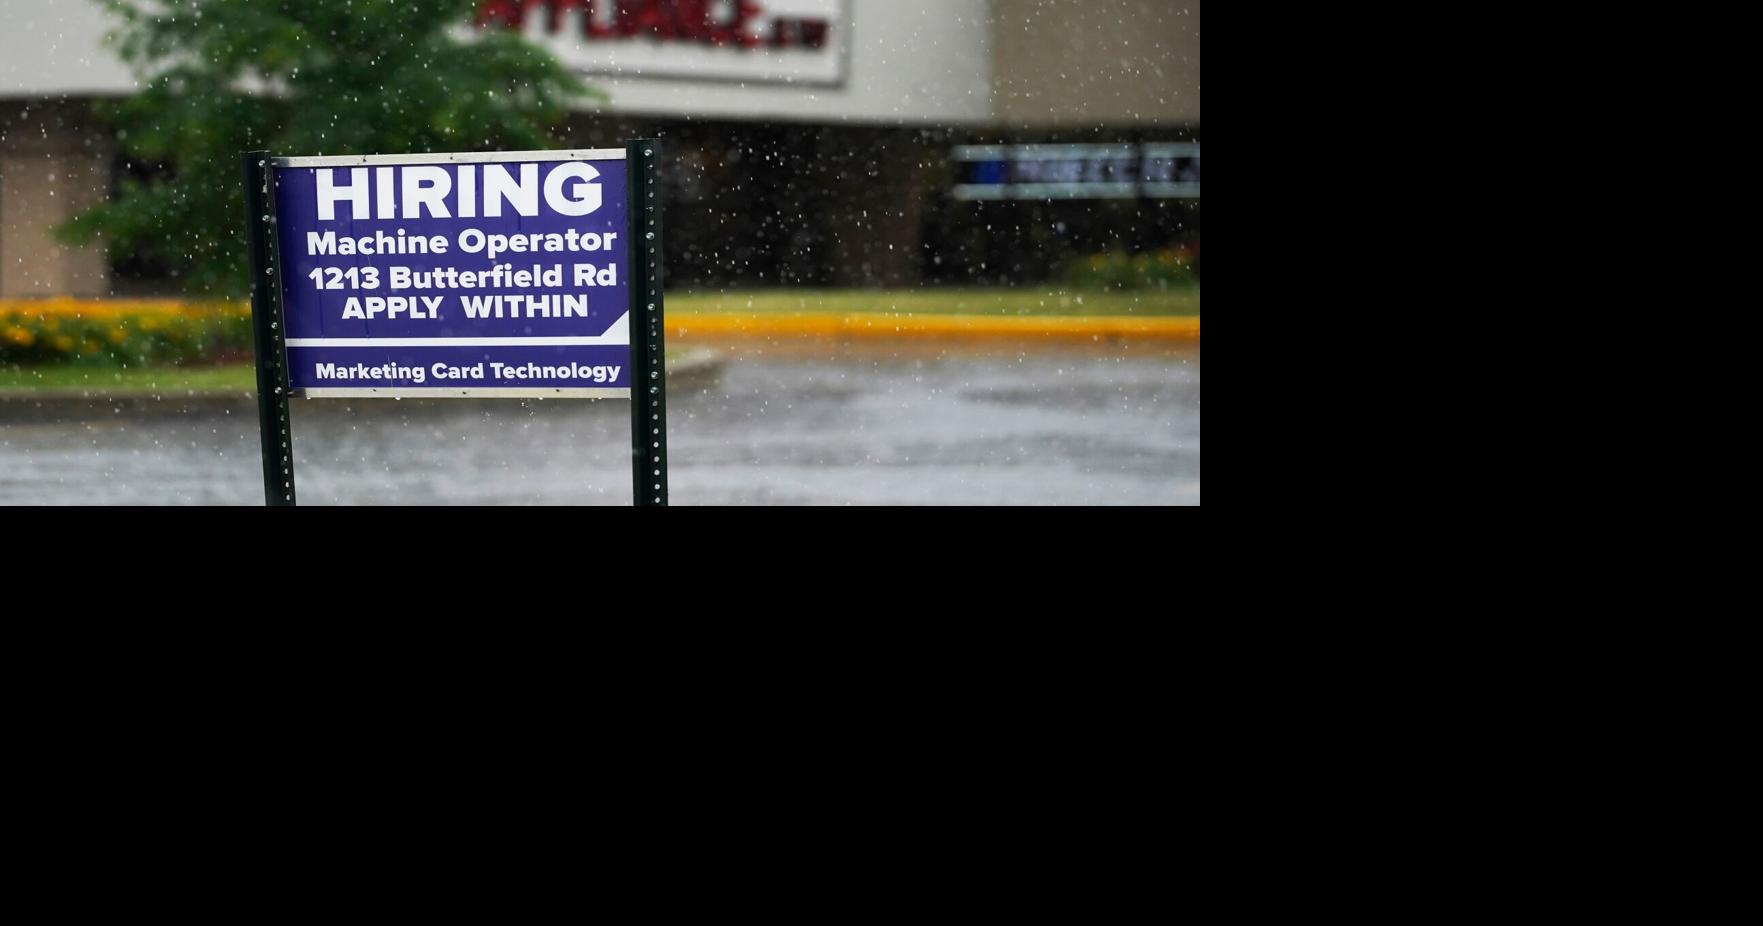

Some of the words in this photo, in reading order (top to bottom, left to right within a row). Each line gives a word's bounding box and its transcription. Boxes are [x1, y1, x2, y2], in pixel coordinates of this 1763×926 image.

[316, 162, 603, 220] HIRING
[307, 229, 449, 256] Machine
[458, 228, 618, 259] Operator
[308, 266, 381, 290] 1213
[389, 262, 563, 290] Butterfield
[573, 262, 617, 287] Rd
[341, 296, 443, 320] APPLY
[460, 294, 588, 319] WITHIN
[315, 362, 426, 384] Marketing
[431, 362, 485, 380] Card
[489, 361, 621, 384] Technology
